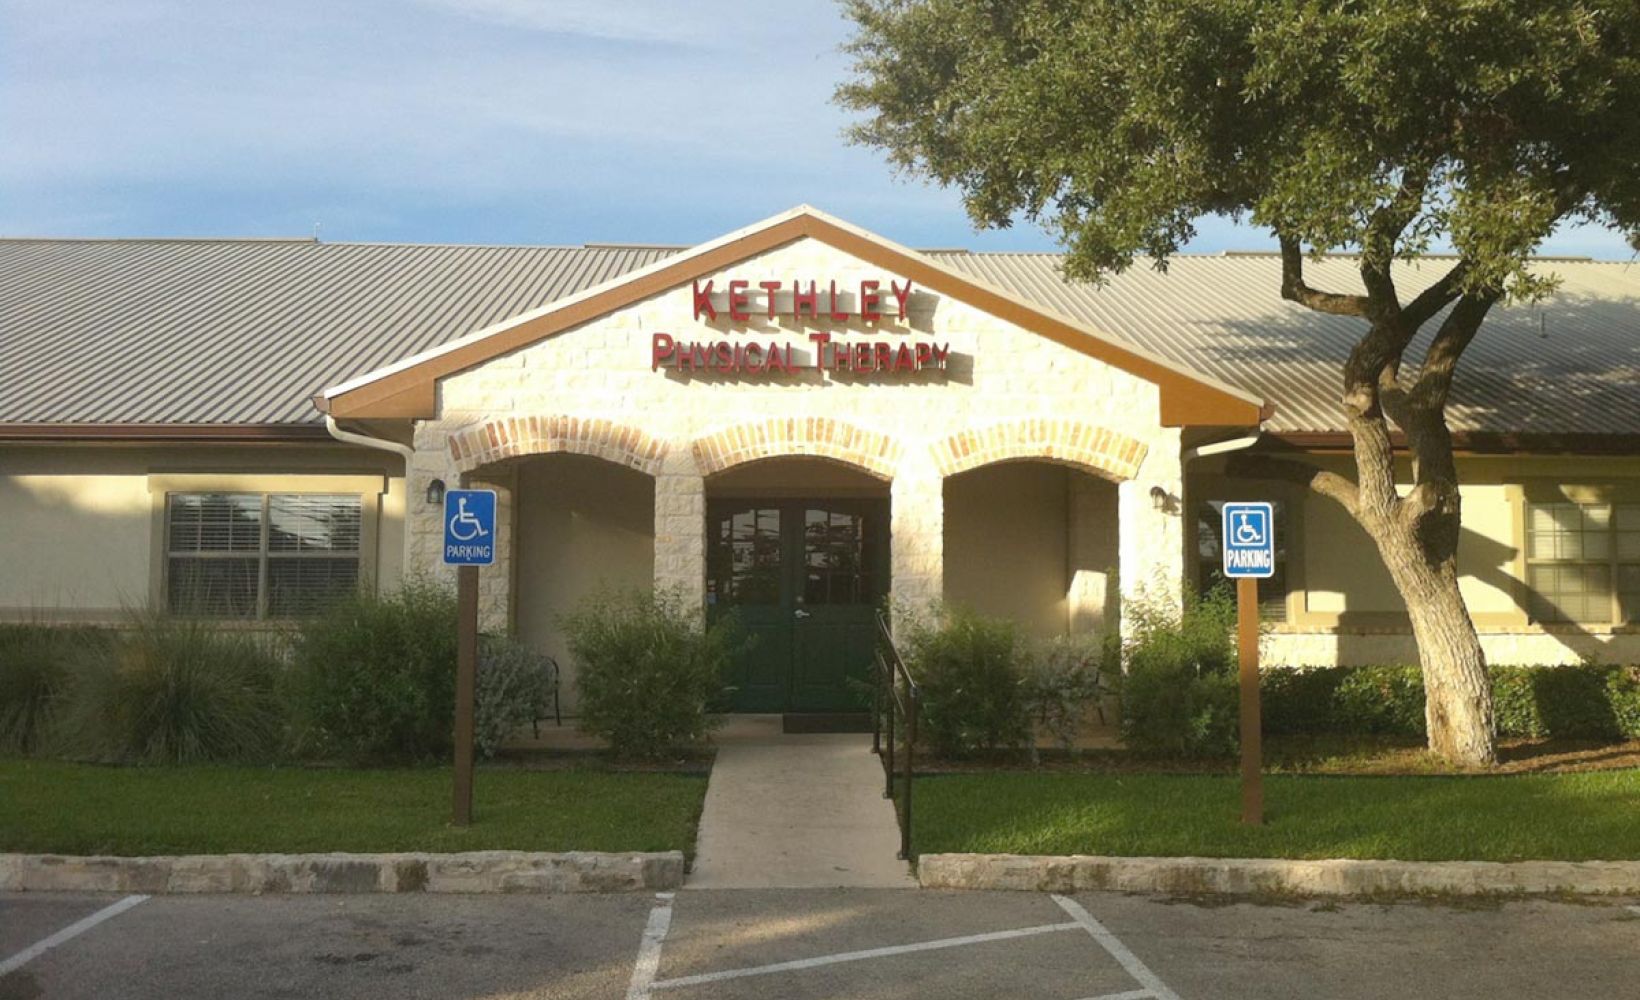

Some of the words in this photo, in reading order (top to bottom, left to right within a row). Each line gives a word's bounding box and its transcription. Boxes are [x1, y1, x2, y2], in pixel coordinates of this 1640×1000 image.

[692, 279, 912, 321] KETHLEY
[652, 333, 800, 373] PHYSICAL
[809, 333, 949, 373] THERAPY
[446, 545, 490, 558] PARKING
[1227, 549, 1271, 569] PARKING
